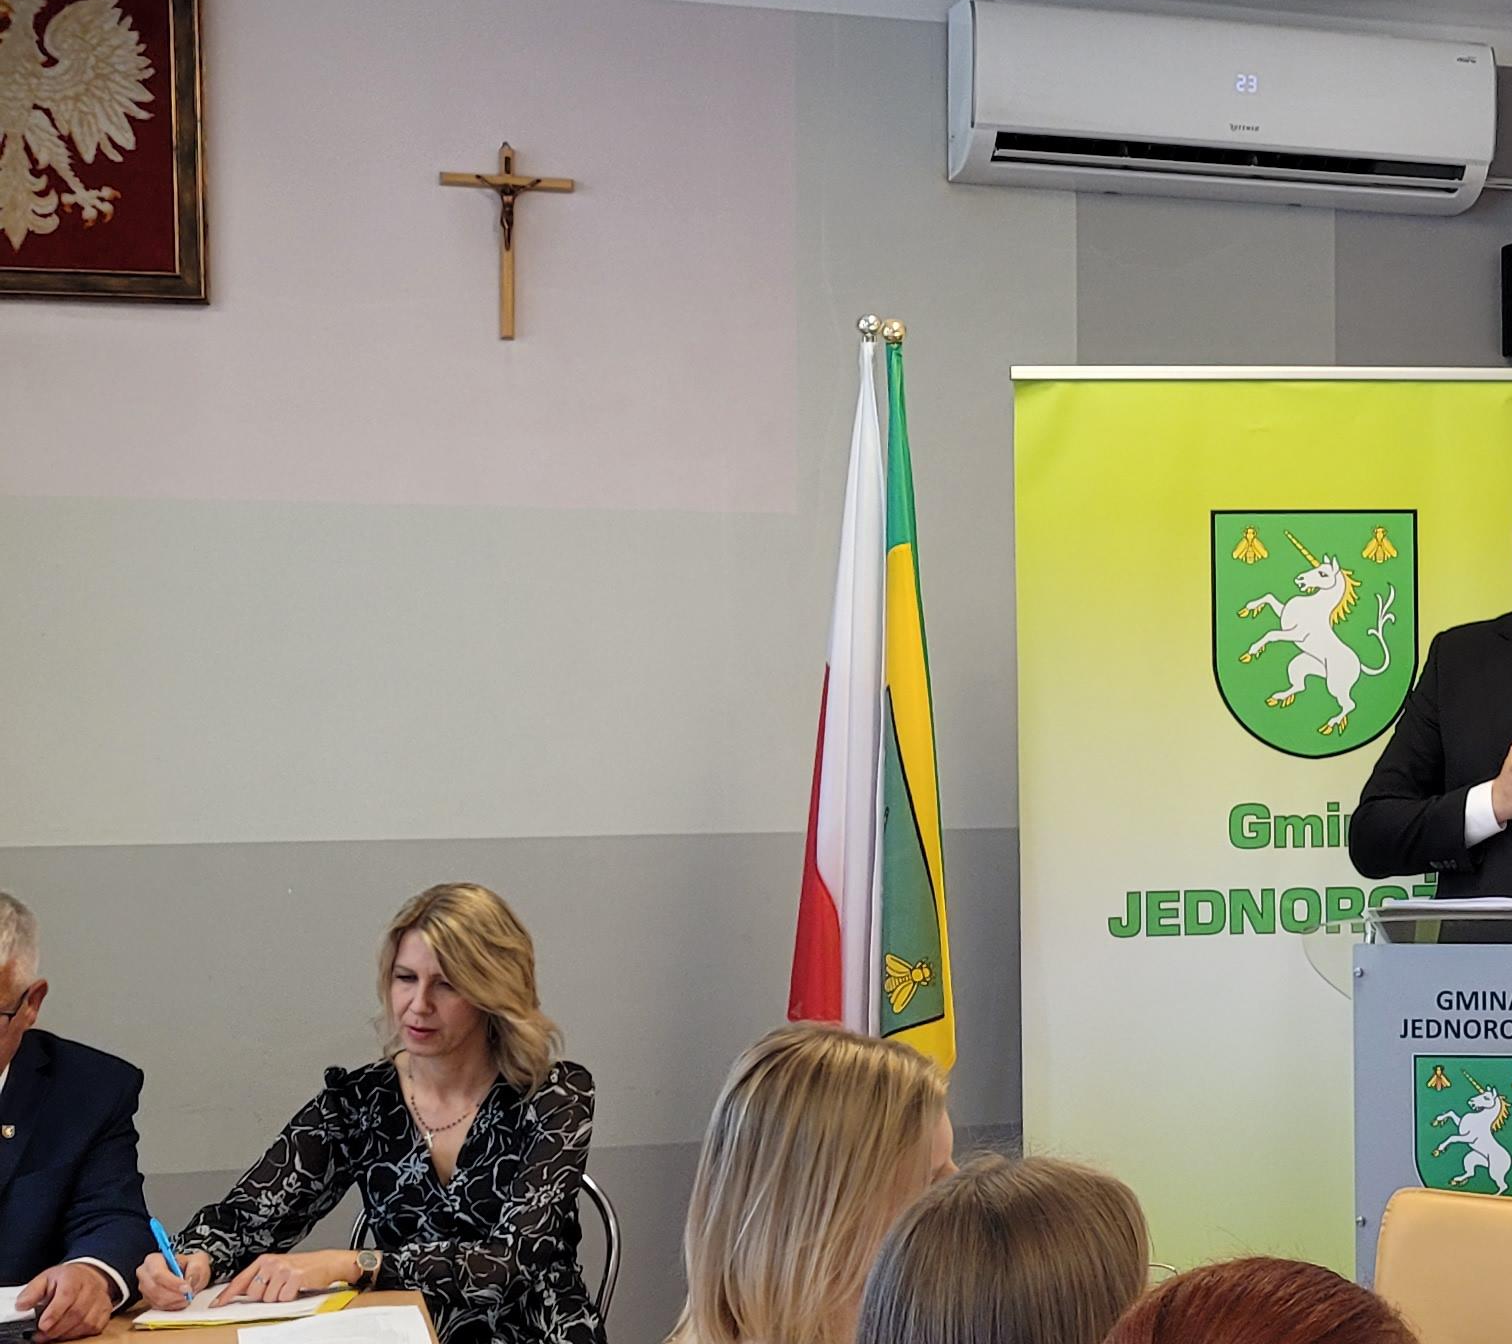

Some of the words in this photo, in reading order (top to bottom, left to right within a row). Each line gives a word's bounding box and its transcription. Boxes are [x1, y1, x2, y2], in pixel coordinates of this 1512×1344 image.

[1235, 73, 1258, 93] 23
[1229, 802, 1350, 849] Gmi
[1108, 874, 1437, 937] JEDNOR
